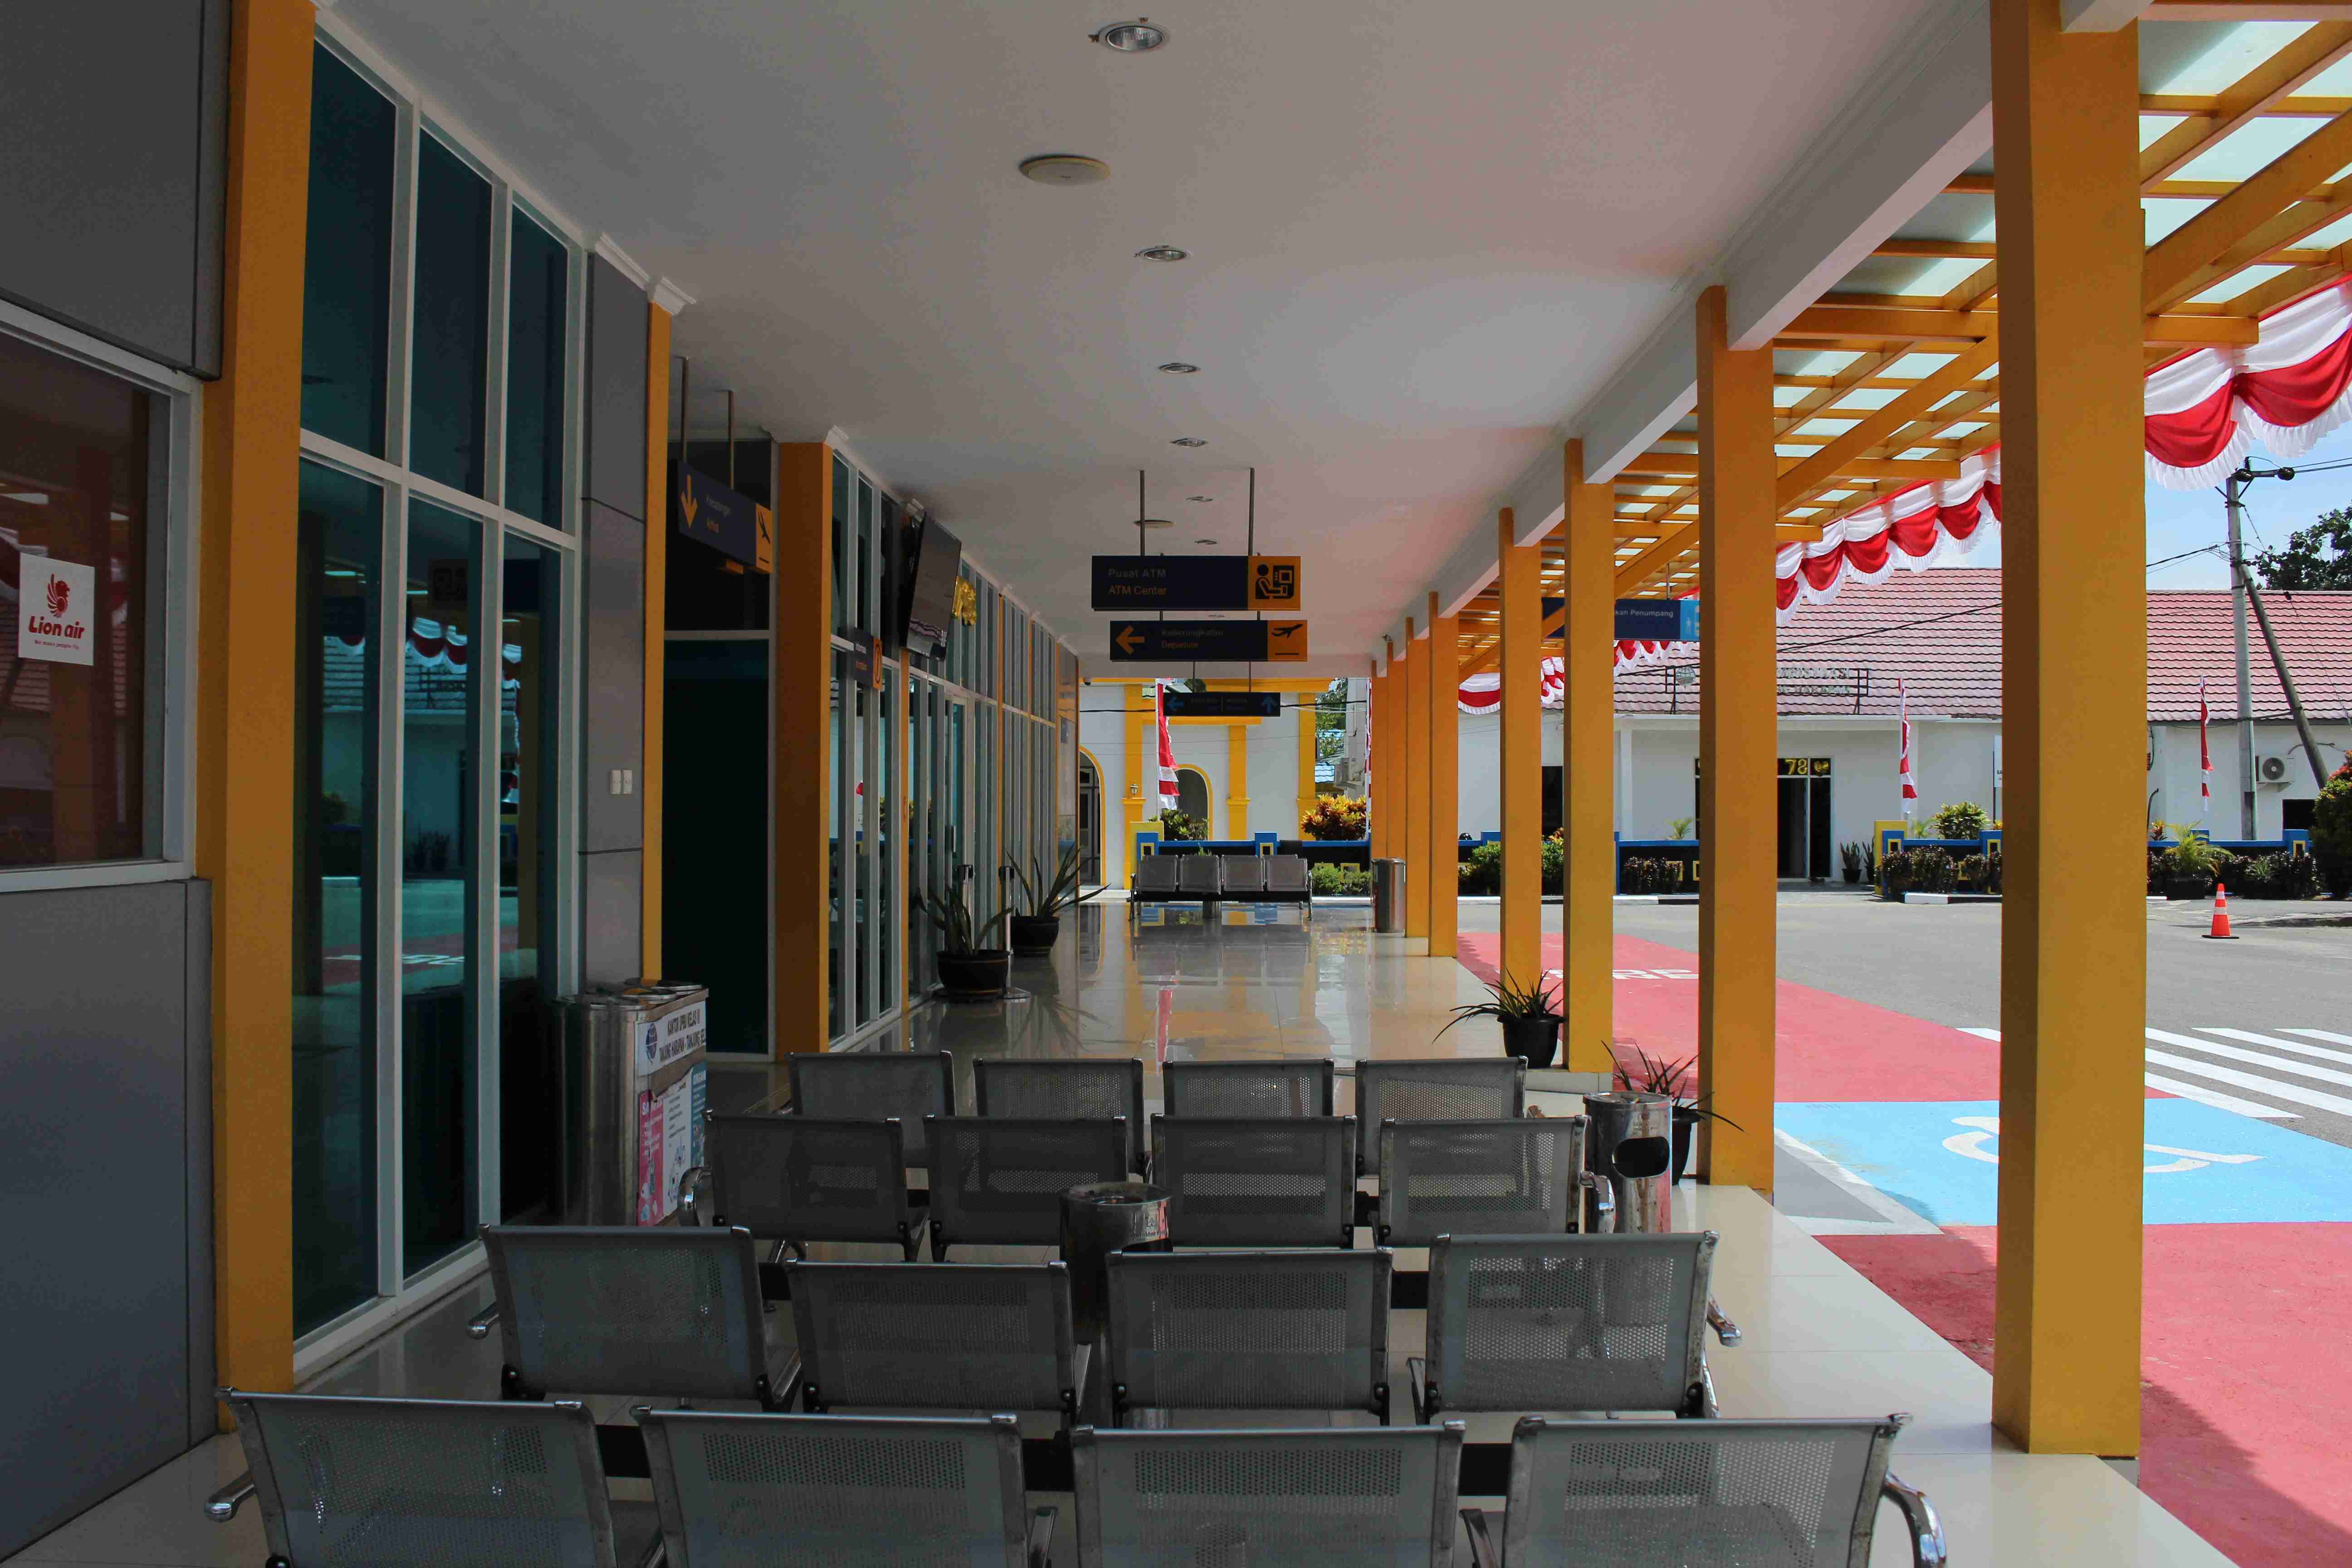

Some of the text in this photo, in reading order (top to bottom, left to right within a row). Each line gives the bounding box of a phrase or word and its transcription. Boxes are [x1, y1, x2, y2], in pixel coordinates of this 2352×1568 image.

[1108, 568, 1166, 578] Pusat ATM
[1108, 585, 1131, 595] ATM
[1630, 609, 1674, 618] Penumpang
[29, 616, 85, 639] Lion air
